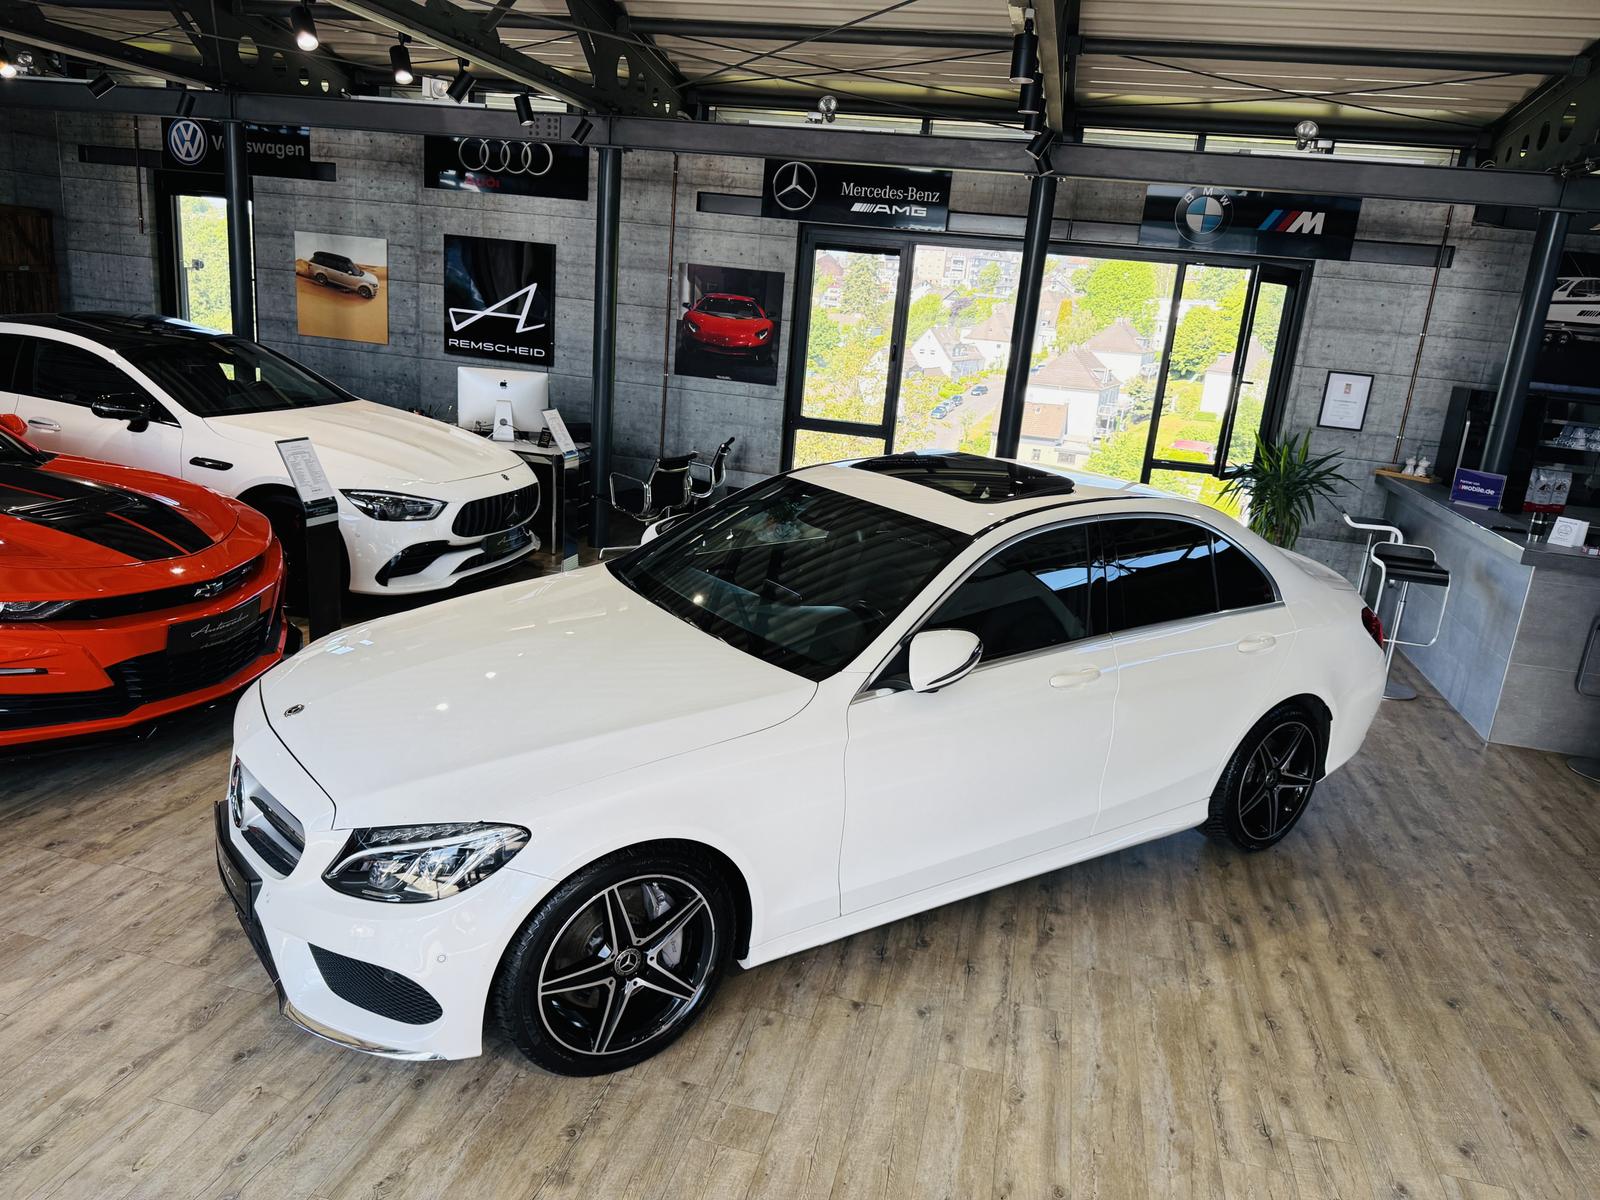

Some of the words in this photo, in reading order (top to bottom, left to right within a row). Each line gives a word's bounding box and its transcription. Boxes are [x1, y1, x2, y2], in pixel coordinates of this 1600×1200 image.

[211, 134, 305, 159] Vswagen
[840, 181, 940, 203] Mercedes-Benz
[873, 203, 927, 217] AMG
[448, 338, 546, 357] REMSCHEID
